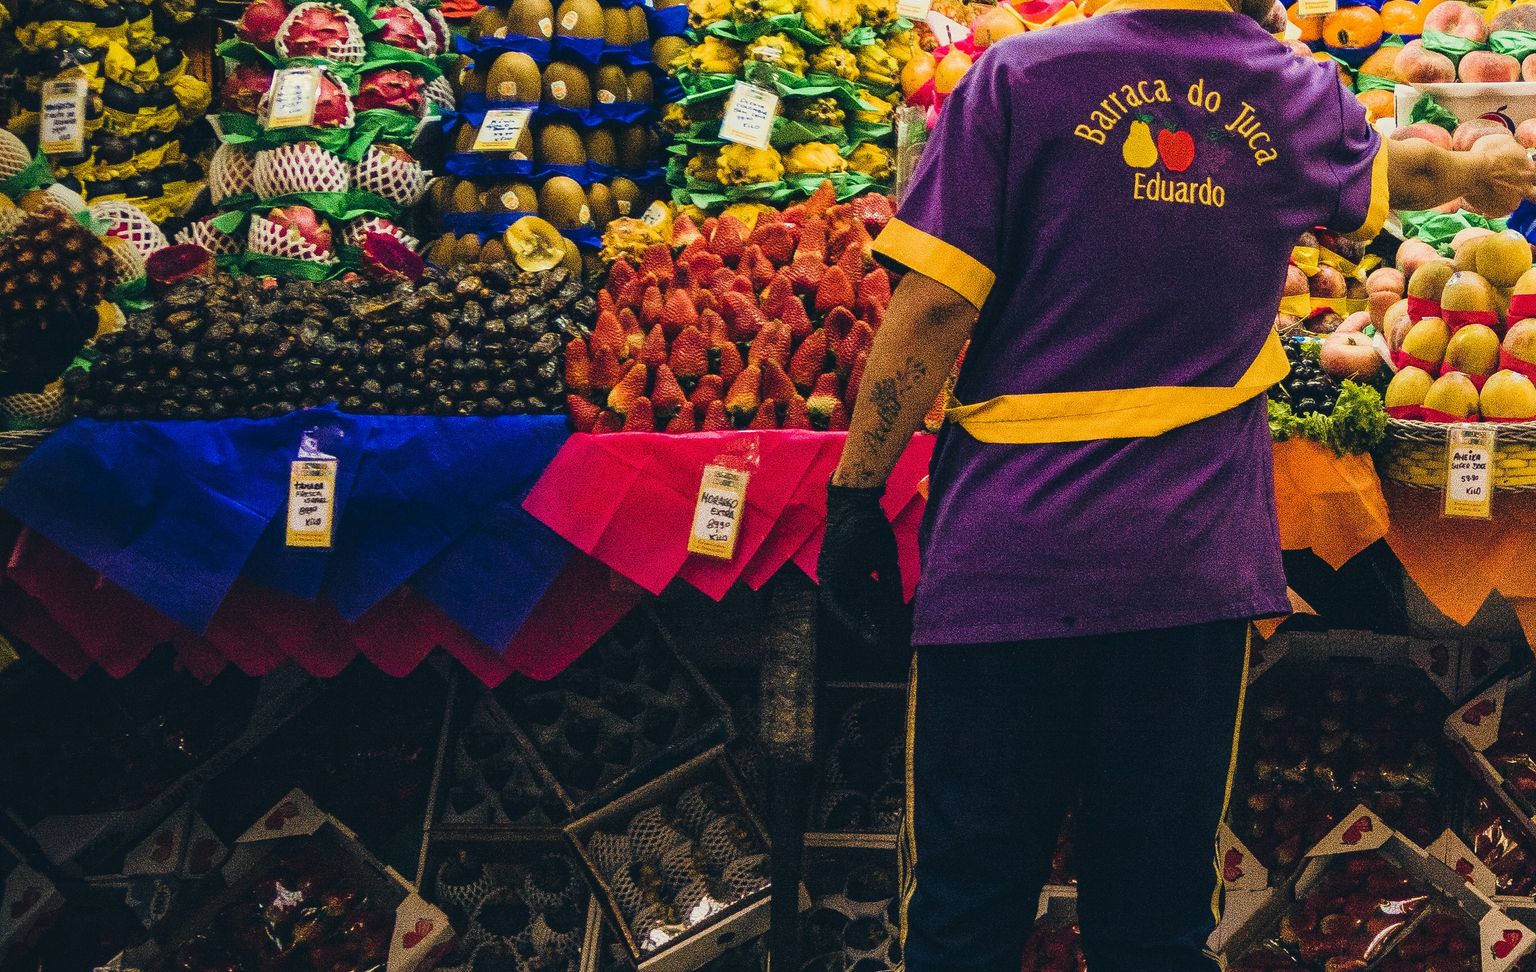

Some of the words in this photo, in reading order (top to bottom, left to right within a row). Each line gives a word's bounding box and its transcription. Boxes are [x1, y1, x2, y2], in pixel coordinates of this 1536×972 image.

[1073, 79, 1172, 146] Barraca
[1187, 78, 1222, 113] do
[1224, 101, 1279, 167] Juca
[1133, 171, 1226, 208] Eduardo
